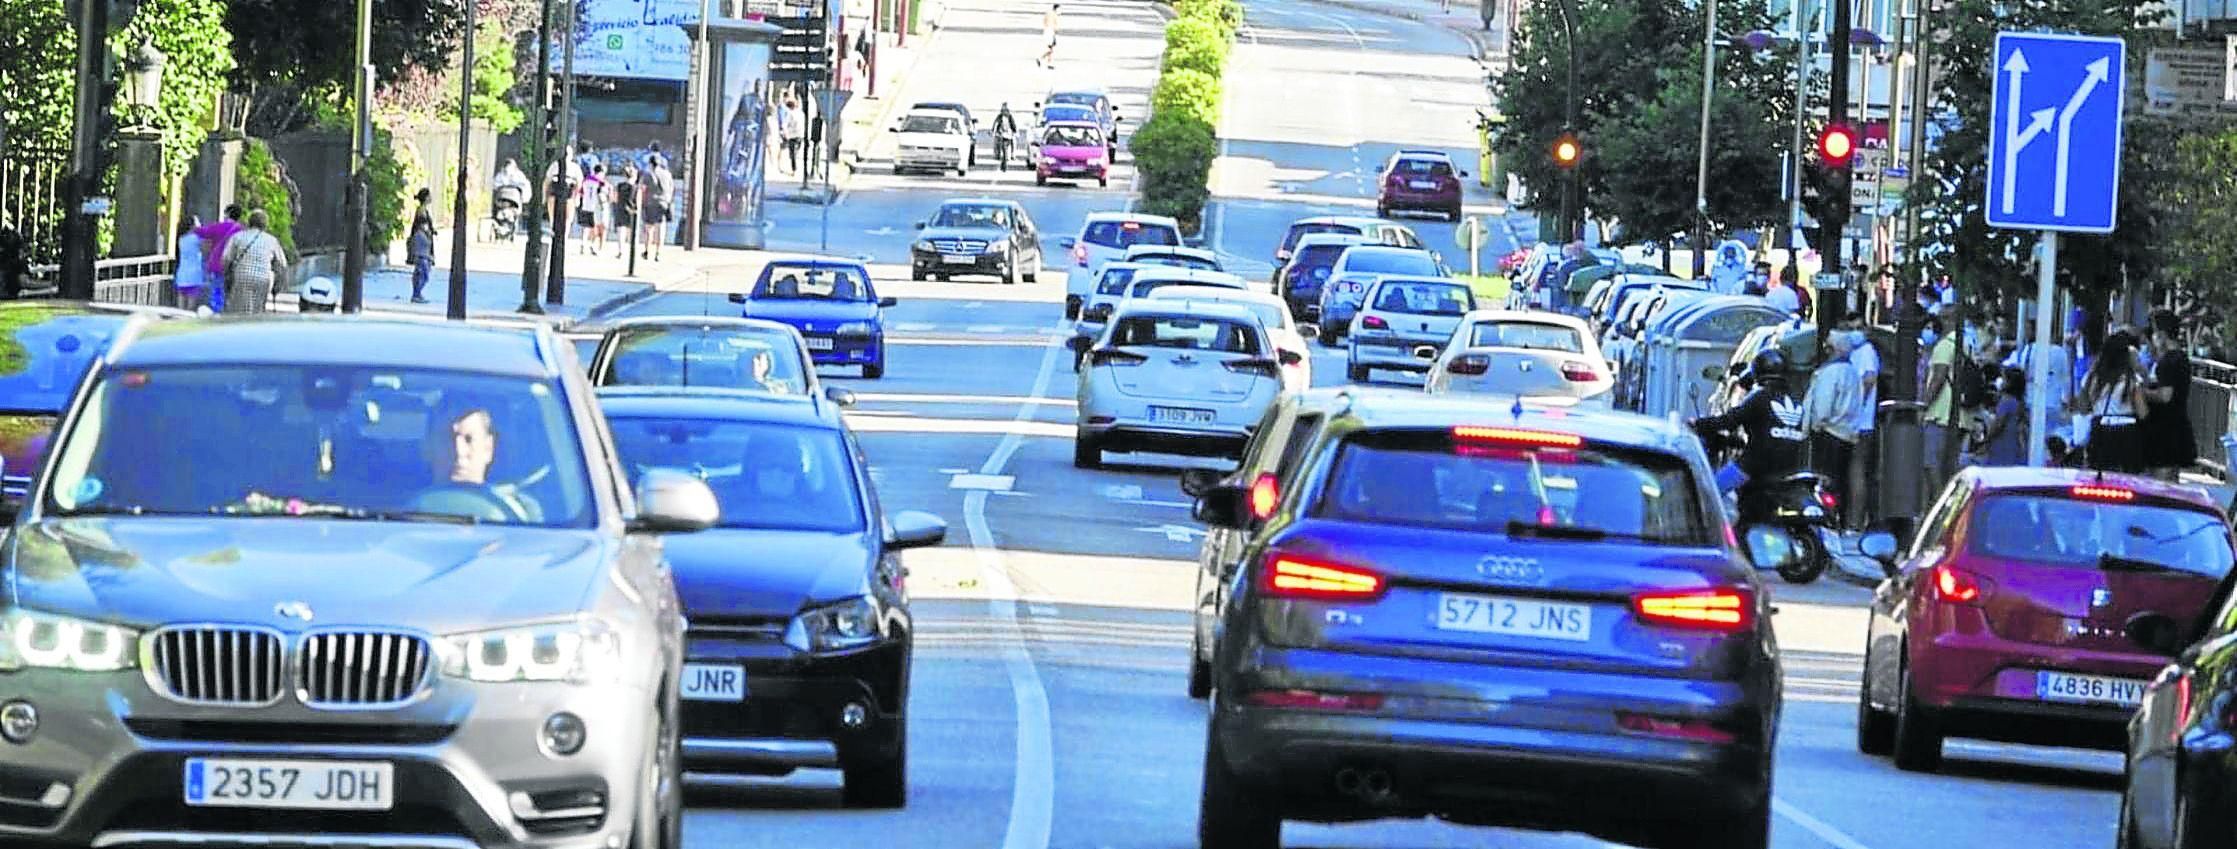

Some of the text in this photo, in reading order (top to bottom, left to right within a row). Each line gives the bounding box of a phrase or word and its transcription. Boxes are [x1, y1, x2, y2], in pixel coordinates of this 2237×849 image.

[1445, 598, 1582, 633] 5712 JNS
[687, 668, 736, 693] JNR
[2053, 677, 2103, 697] 4836
[212, 767, 380, 801] 2357 JDH
